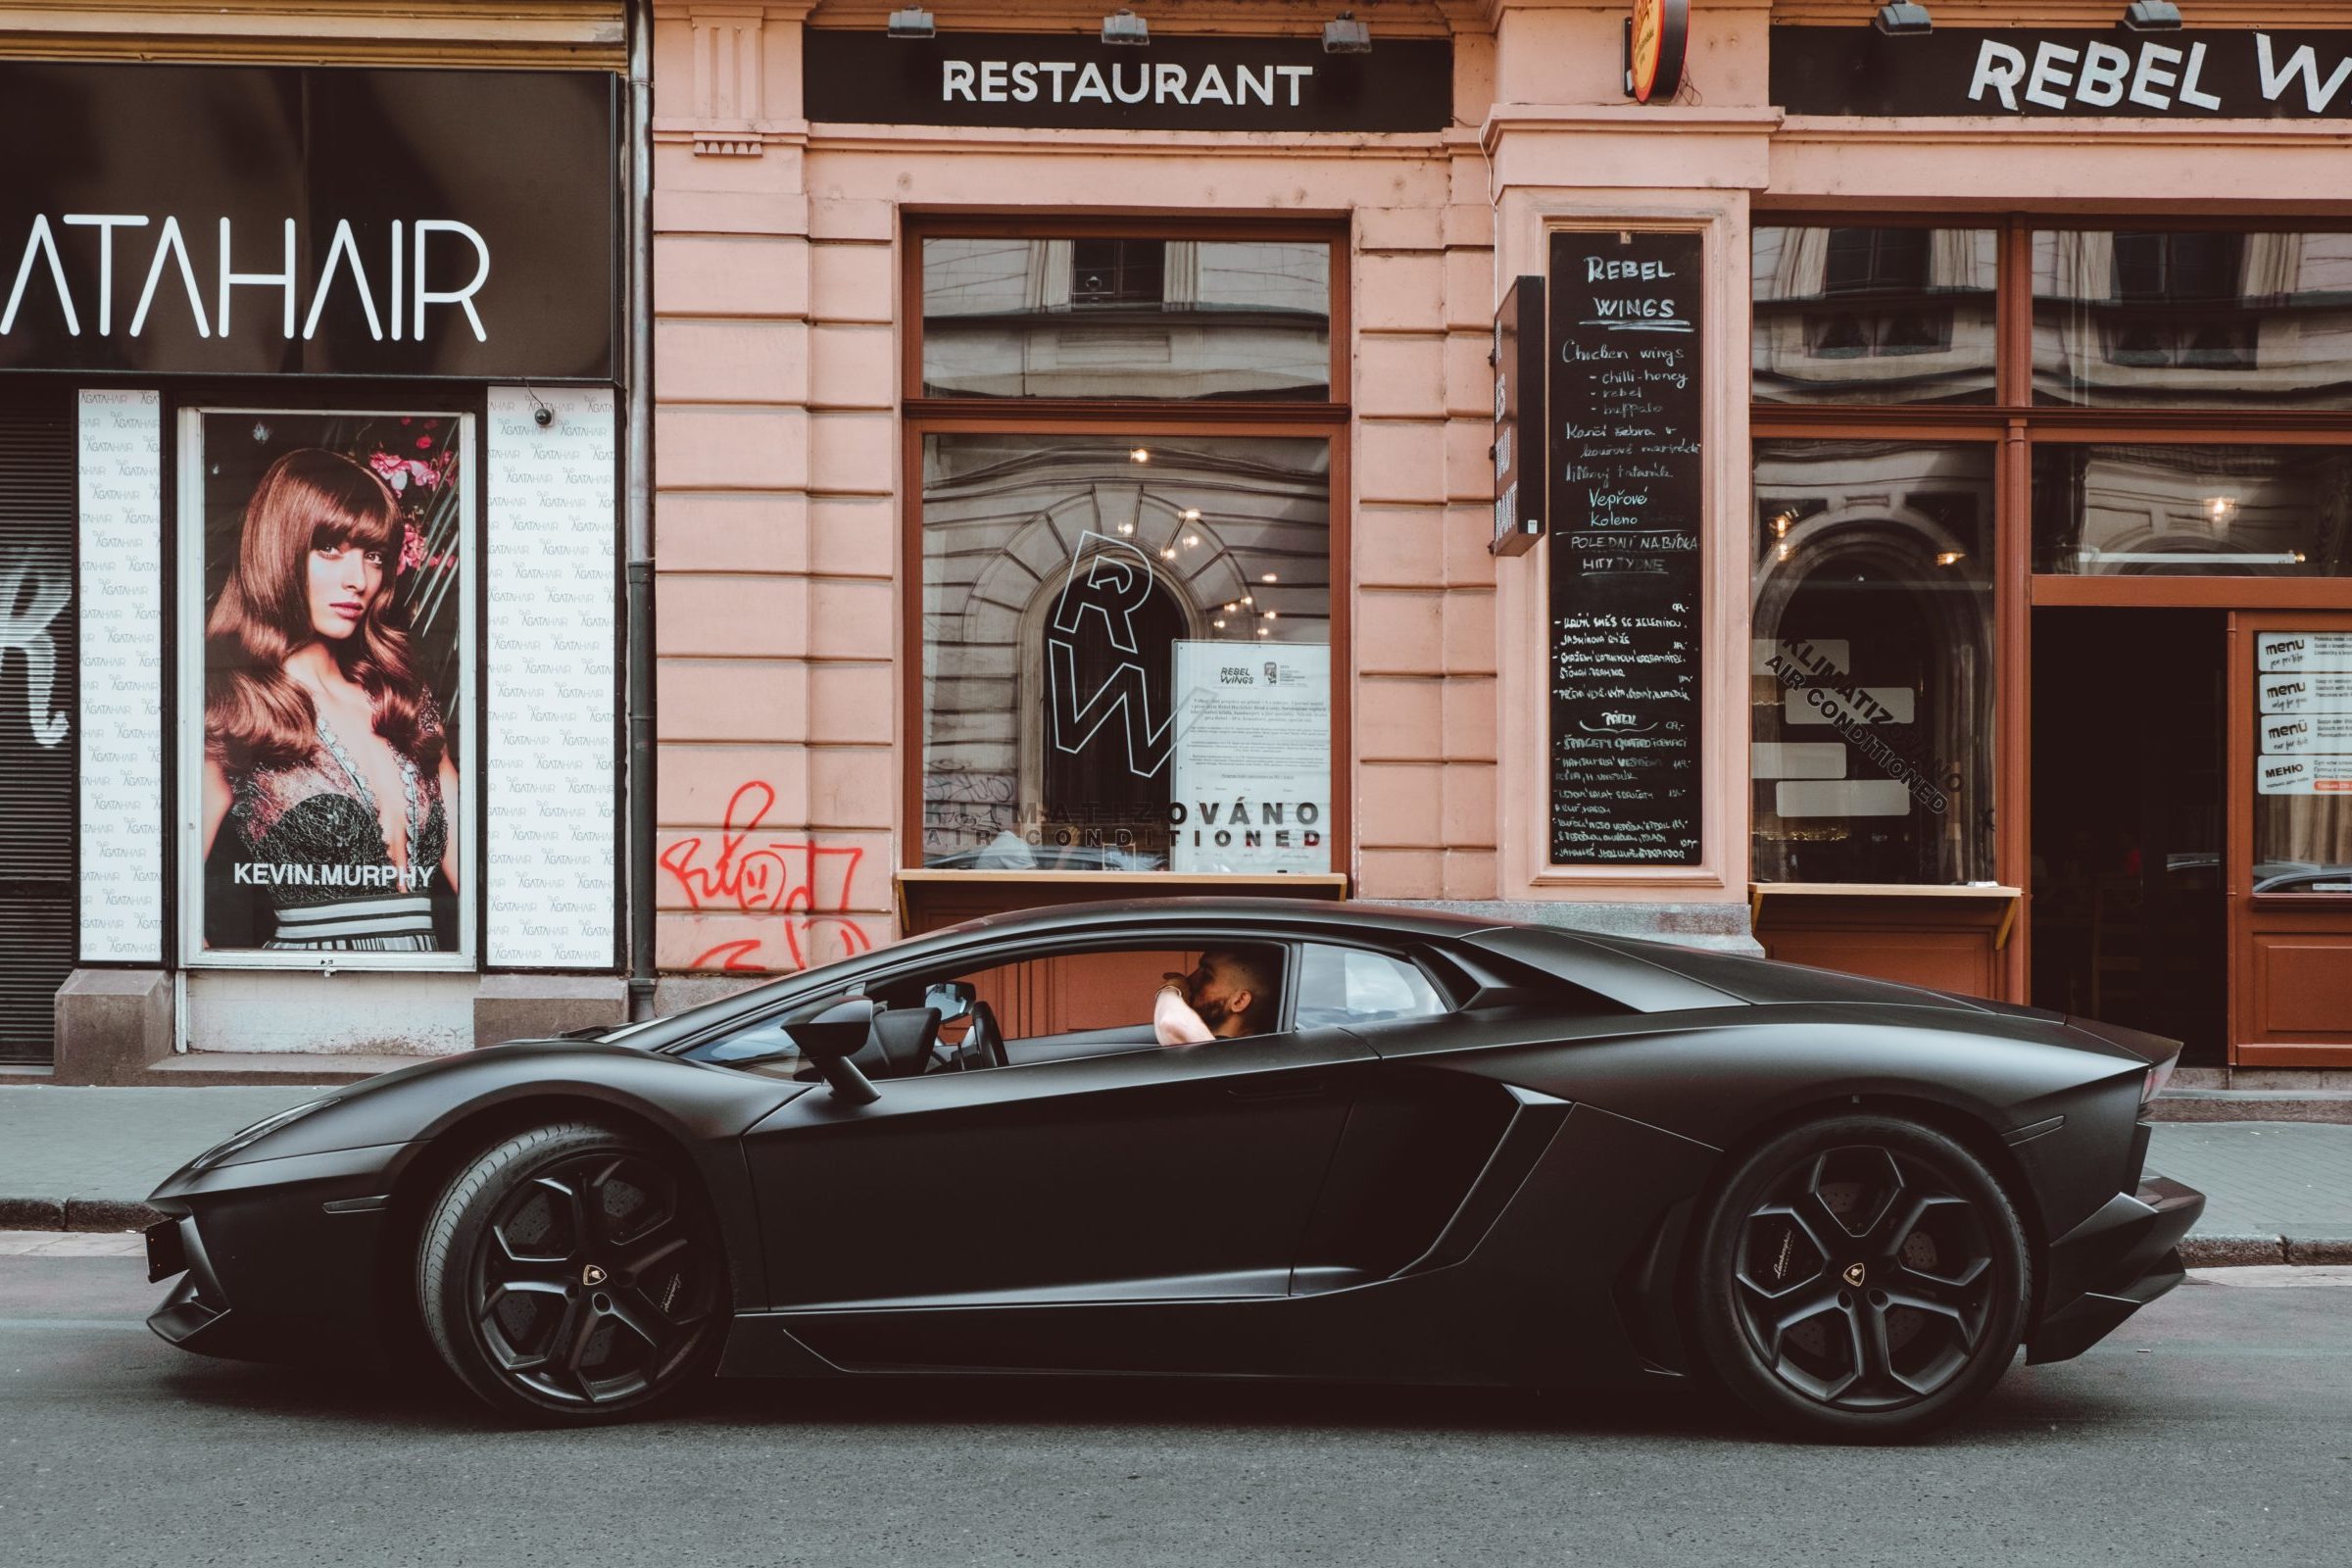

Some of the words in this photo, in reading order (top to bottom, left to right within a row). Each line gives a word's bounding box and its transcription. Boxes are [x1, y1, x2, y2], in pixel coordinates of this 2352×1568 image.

[942, 59, 1313, 106] RESTAURANT
[1967, 39, 2221, 111] REBEL
[2256, 32, 2352, 114] W
[0, 214, 490, 342] ATAHAIR
[1584, 256, 1676, 282] REBEL
[1592, 297, 1675, 318] WINGS
[1563, 339, 1629, 363] Chicken
[1641, 347, 1685, 367] wings
[1602, 387, 1642, 398] rebel
[1589, 486, 1648, 512] Vepřové
[1583, 558, 1613, 569] HITY
[2266, 639, 2304, 656] menu
[1220, 675, 1254, 684] WINGS
[1221, 666, 1250, 676] REBEL
[2267, 682, 2305, 698] menu
[1764, 654, 1806, 692] AIR
[1806, 688, 1949, 814] CONDITIONED
[2268, 719, 2307, 739] menü
[2265, 764, 2303, 778] МЕНЮ
[925, 829, 992, 848] AIR
[1022, 828, 1321, 848] CONDITIONED
[234, 862, 435, 887] KEVIN.MURPHY
